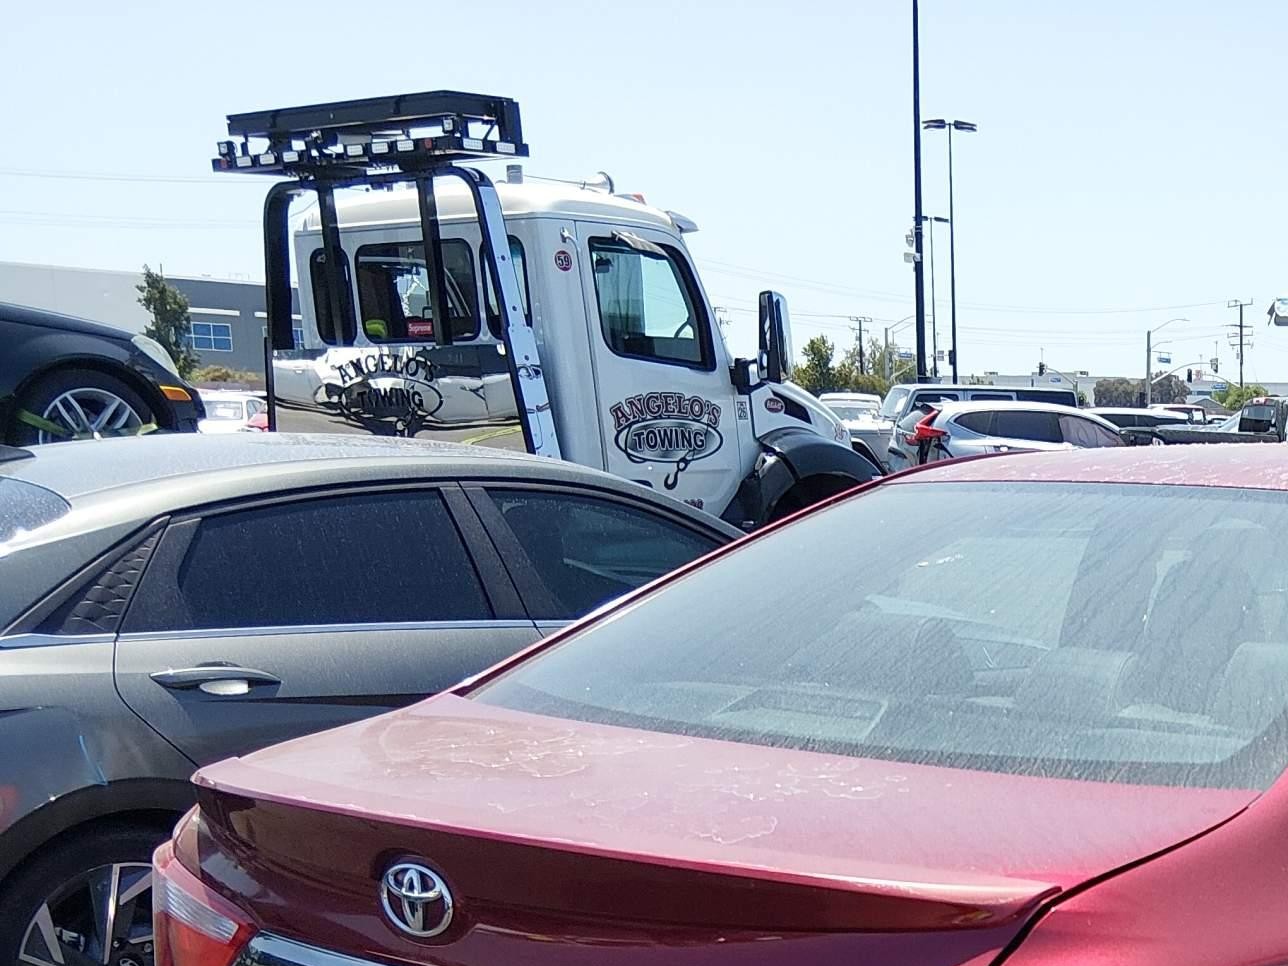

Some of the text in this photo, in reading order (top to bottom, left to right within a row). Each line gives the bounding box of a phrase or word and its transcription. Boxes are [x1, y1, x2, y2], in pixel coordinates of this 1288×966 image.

[557, 255, 570, 267] 59
[357, 386, 424, 408] TOWING
[610, 392, 721, 431] ANGELO'S
[632, 426, 706, 450] TOWING
